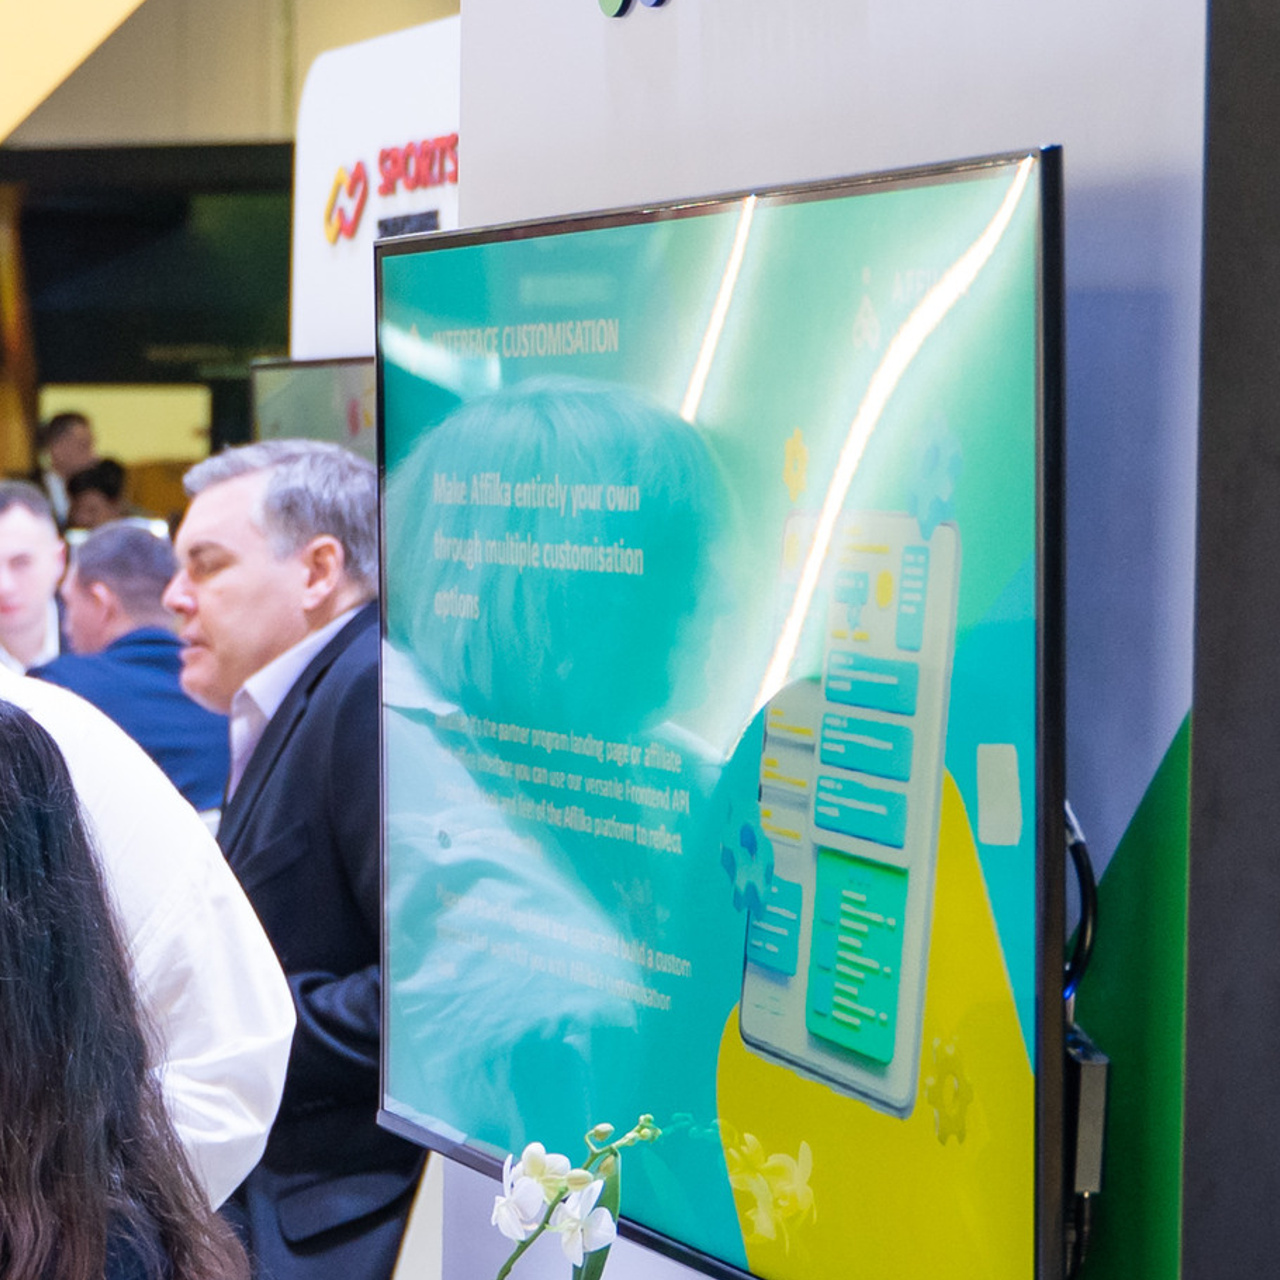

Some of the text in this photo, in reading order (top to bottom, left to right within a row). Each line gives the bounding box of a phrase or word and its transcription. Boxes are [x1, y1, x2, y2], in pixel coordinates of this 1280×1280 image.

[502, 319, 619, 358] CUSTOMISATION
[433, 472, 639, 517] Make Affilka entirely your own
[434, 530, 644, 575] through multiple customisation
[434, 587, 480, 621] options
